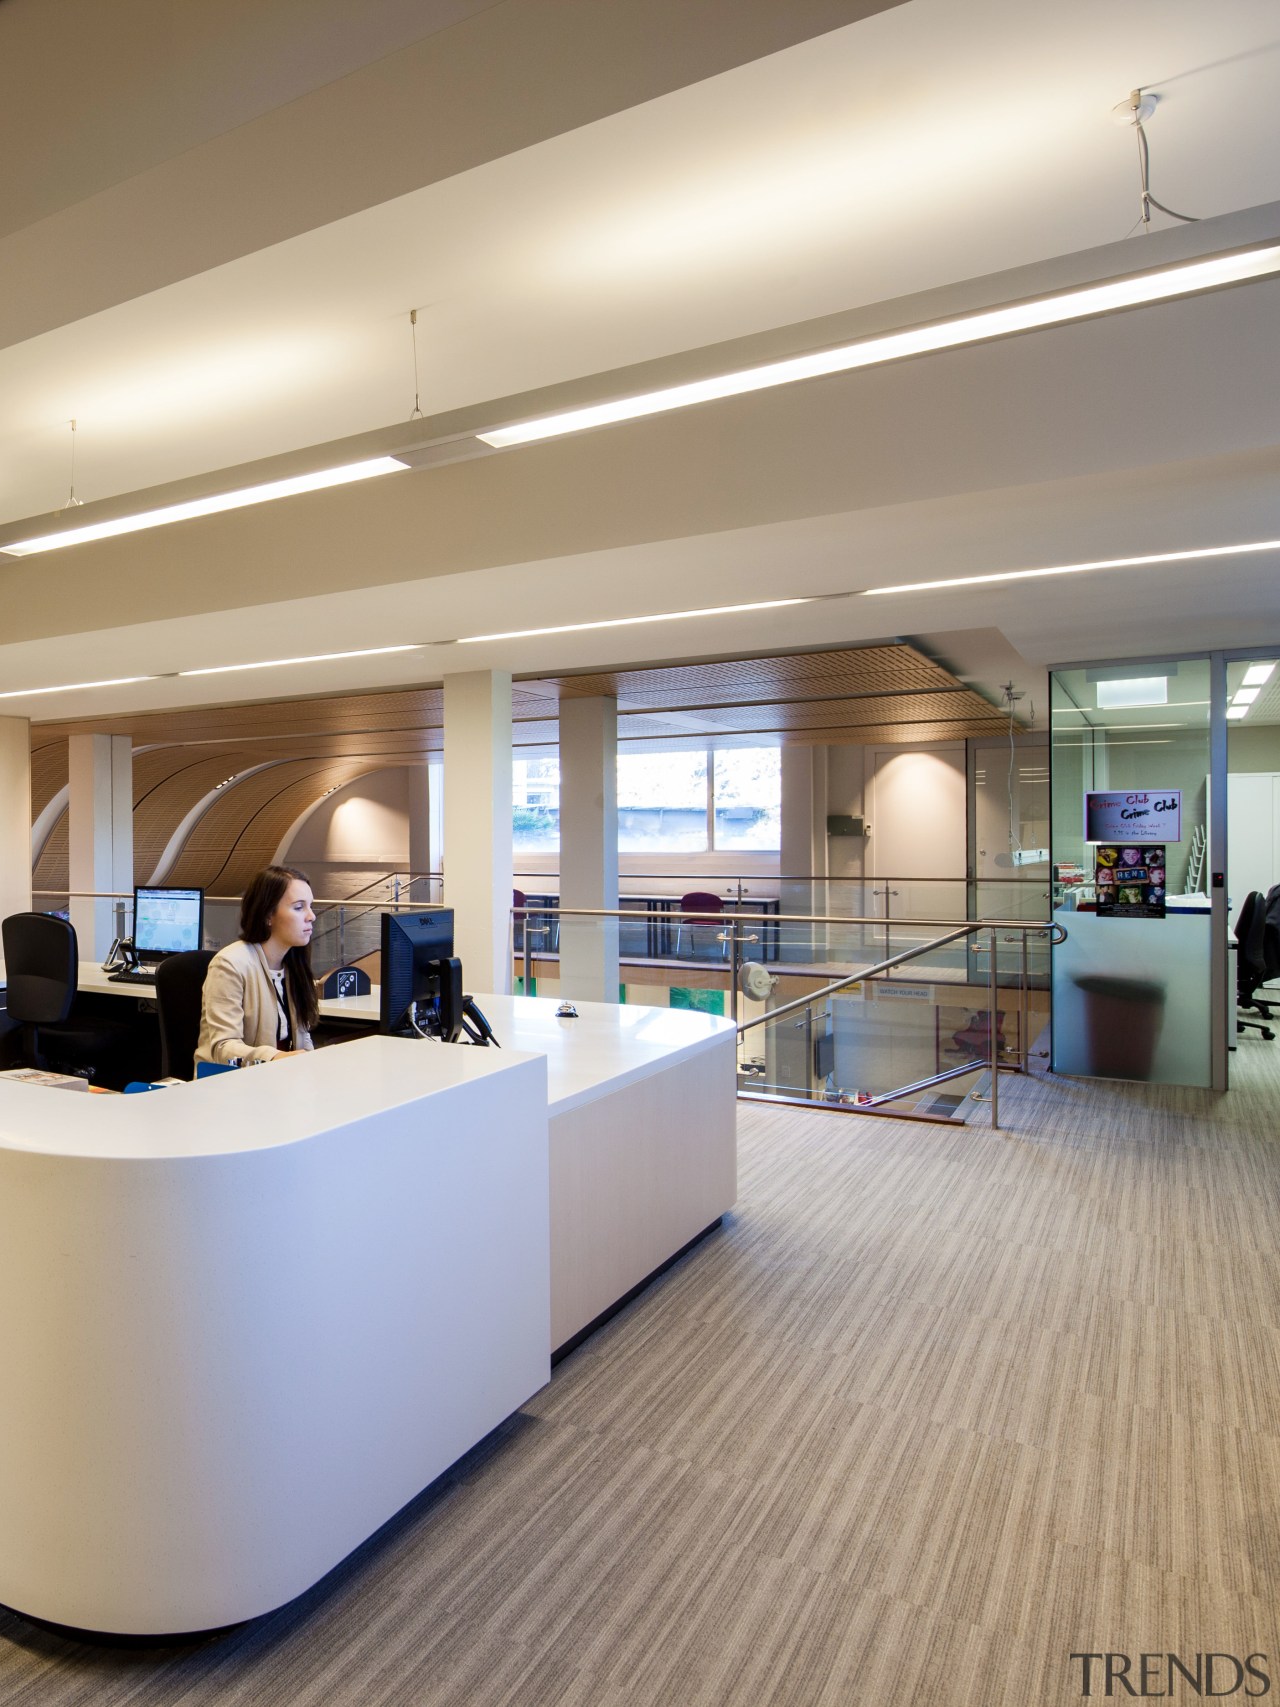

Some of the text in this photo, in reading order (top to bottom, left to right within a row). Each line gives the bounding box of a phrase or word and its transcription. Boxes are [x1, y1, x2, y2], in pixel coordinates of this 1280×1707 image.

[1090, 794, 1149, 811] Crime Club
[1121, 798, 1178, 819] Crime Club
[1117, 870, 1145, 879] RENT
